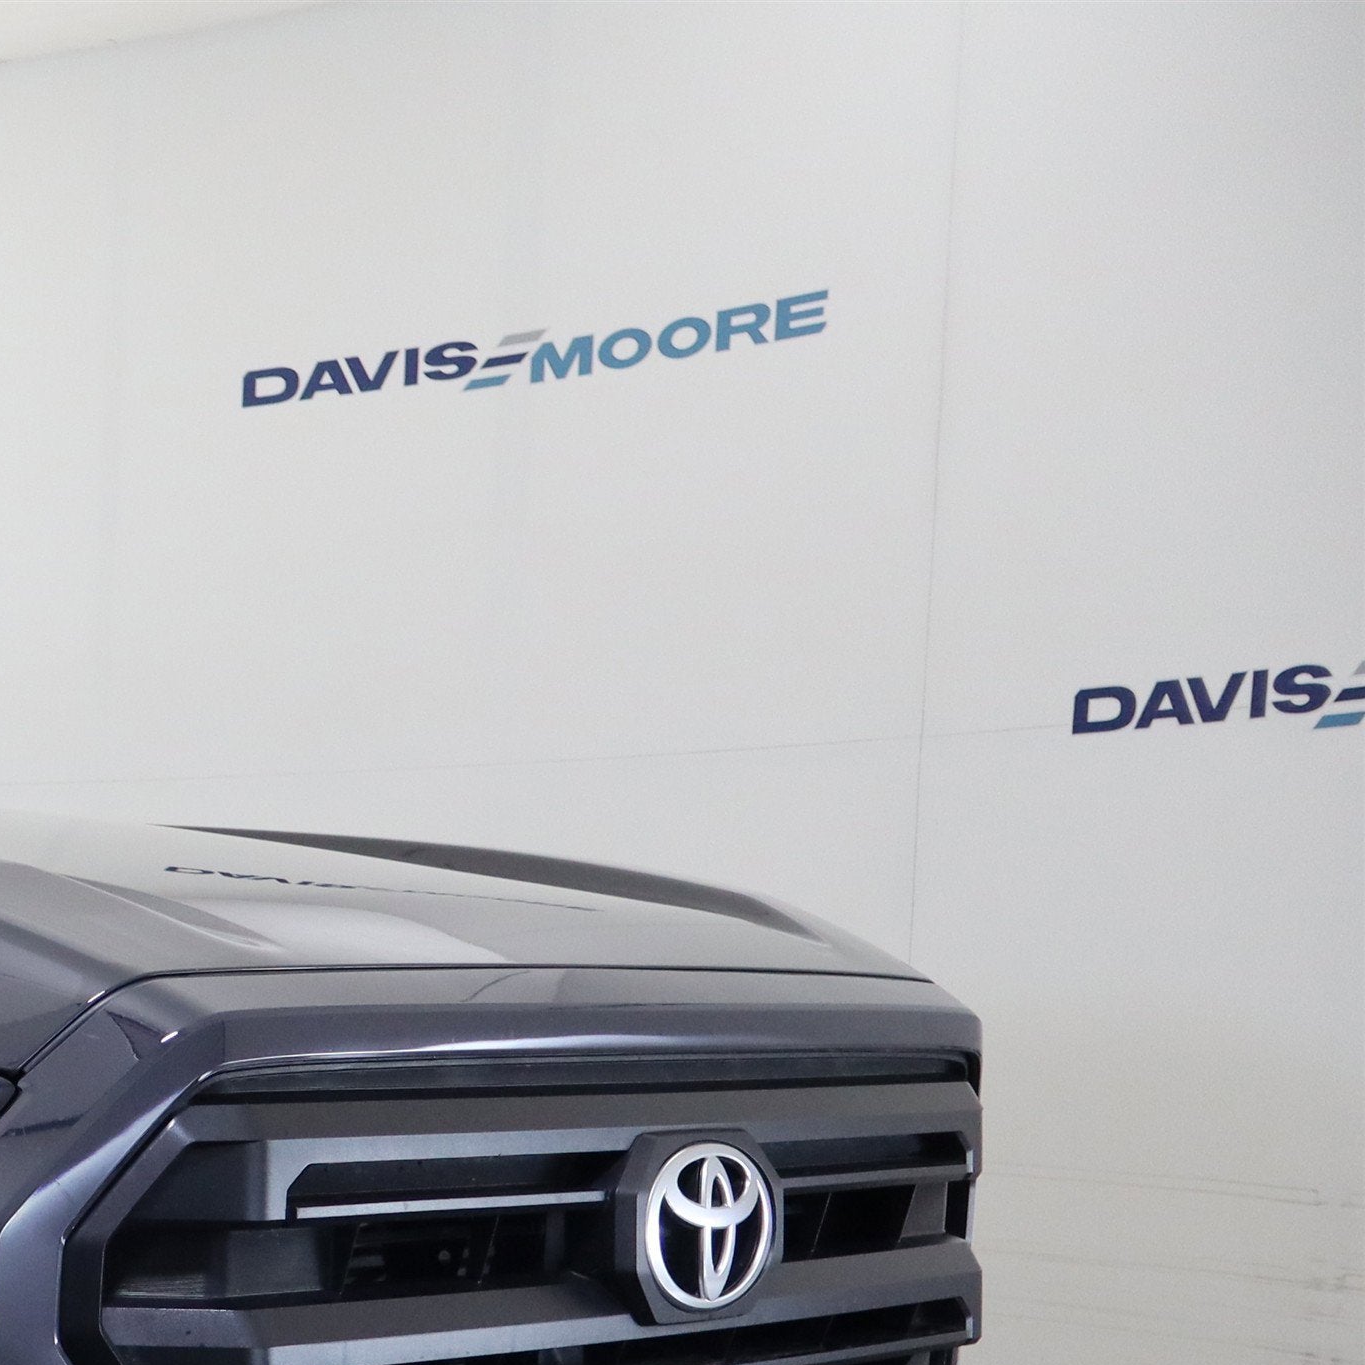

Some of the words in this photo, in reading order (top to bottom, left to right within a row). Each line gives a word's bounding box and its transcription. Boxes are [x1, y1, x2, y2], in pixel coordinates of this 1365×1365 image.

[241, 340, 480, 409] DAVIS
[529, 289, 829, 384] MOORE
[1072, 664, 1334, 735] DAVIS
